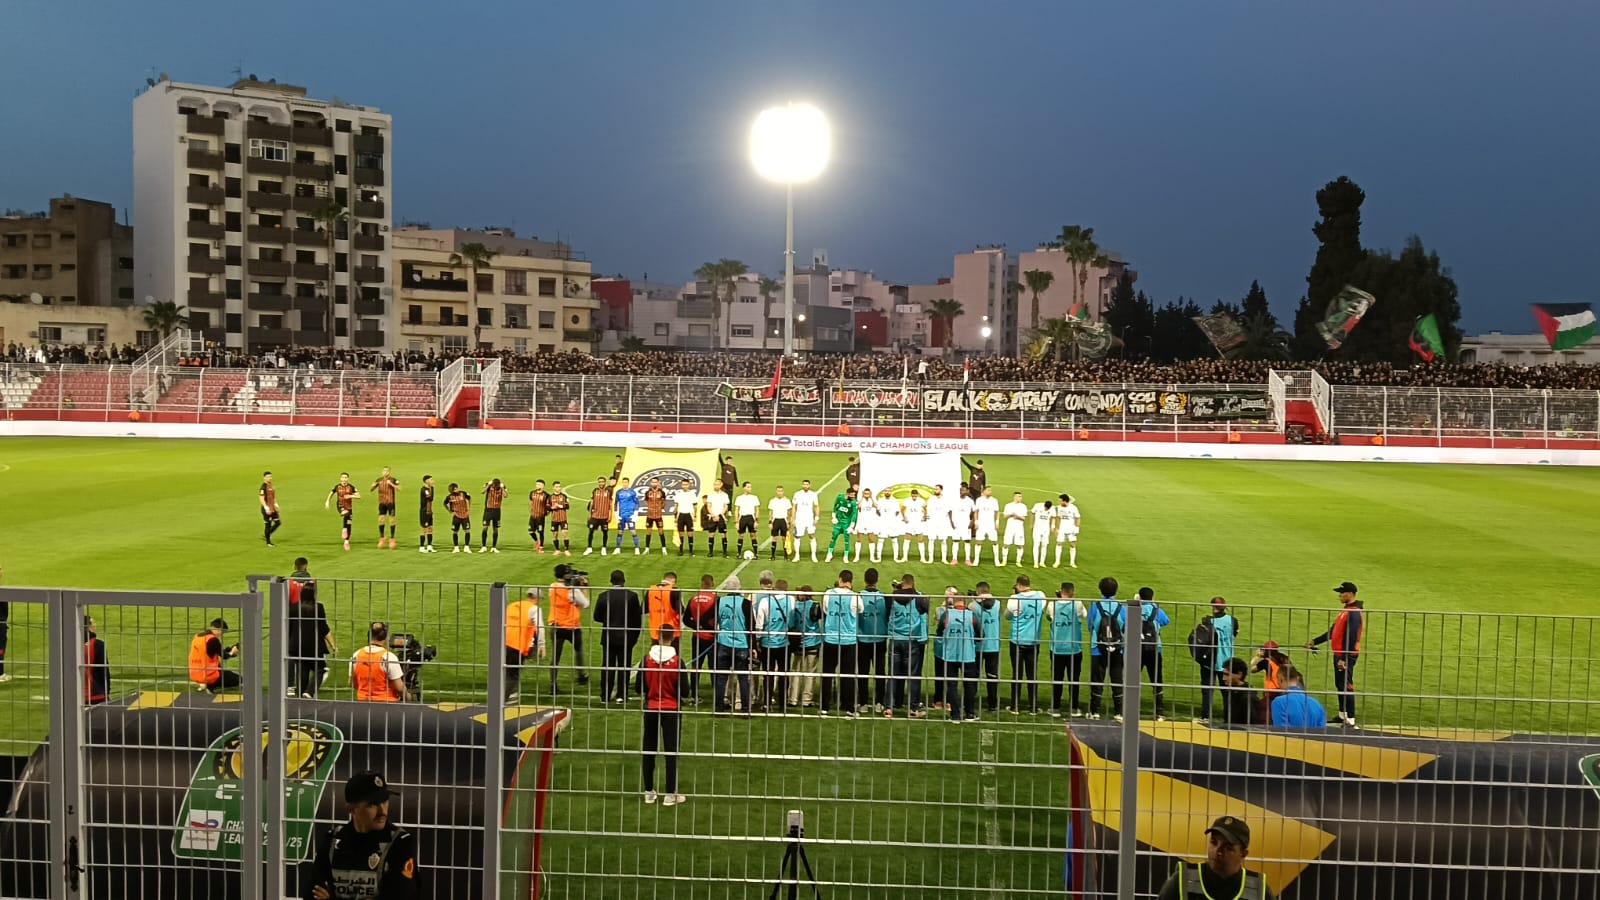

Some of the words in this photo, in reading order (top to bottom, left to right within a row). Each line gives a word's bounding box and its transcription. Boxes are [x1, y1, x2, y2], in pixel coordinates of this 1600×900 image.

[923, 390, 984, 412] BLACK
[794, 440, 852, 449] TotalEnergies
[880, 442, 931, 450] CHAMPIONS
